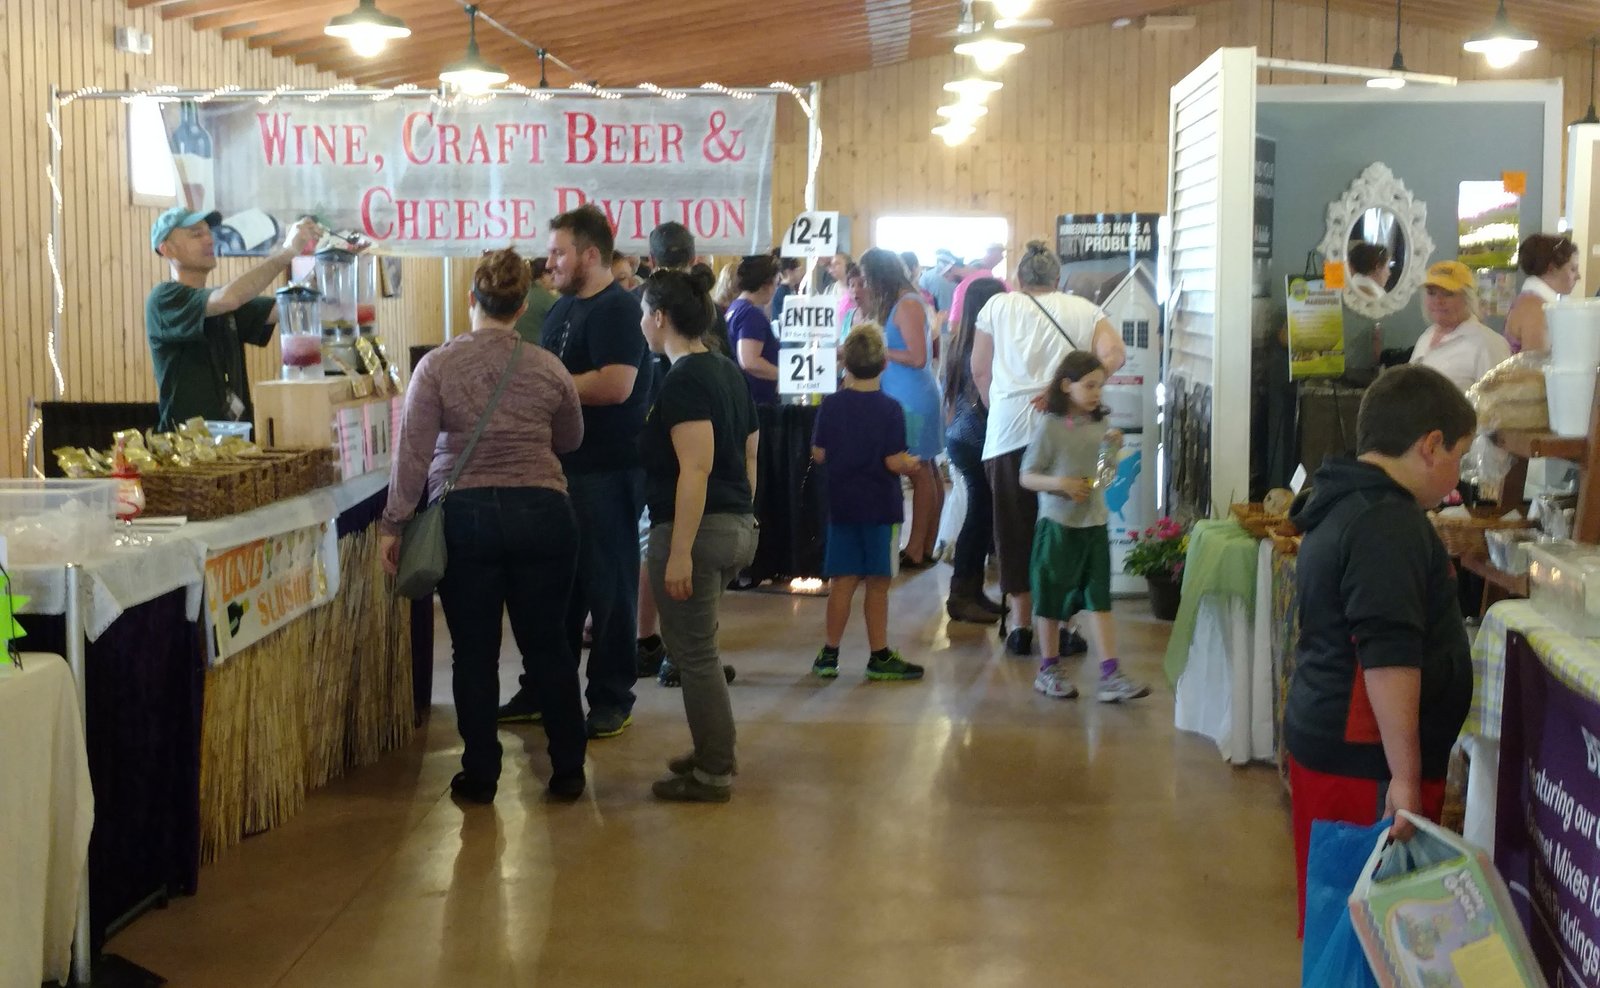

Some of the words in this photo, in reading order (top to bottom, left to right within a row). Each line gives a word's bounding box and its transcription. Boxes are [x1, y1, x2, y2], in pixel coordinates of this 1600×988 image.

[256, 112, 384, 173] WINE,
[402, 111, 548, 165] CRAFT
[563, 111, 686, 164] BEER
[702, 110, 746, 163] &
[361, 185, 537, 240] CHEESE
[554, 186, 747, 240] PVILION
[789, 217, 832, 244] 12-4
[1113, 222, 1141, 235] HAVE
[1142, 222, 1151, 235] A
[1084, 234, 1151, 253] PROBLEM
[784, 306, 834, 328] ENTER
[790, 354, 825, 381] 21+
[1575, 804, 1597, 840] our
[1553, 841, 1590, 904] Mixes
